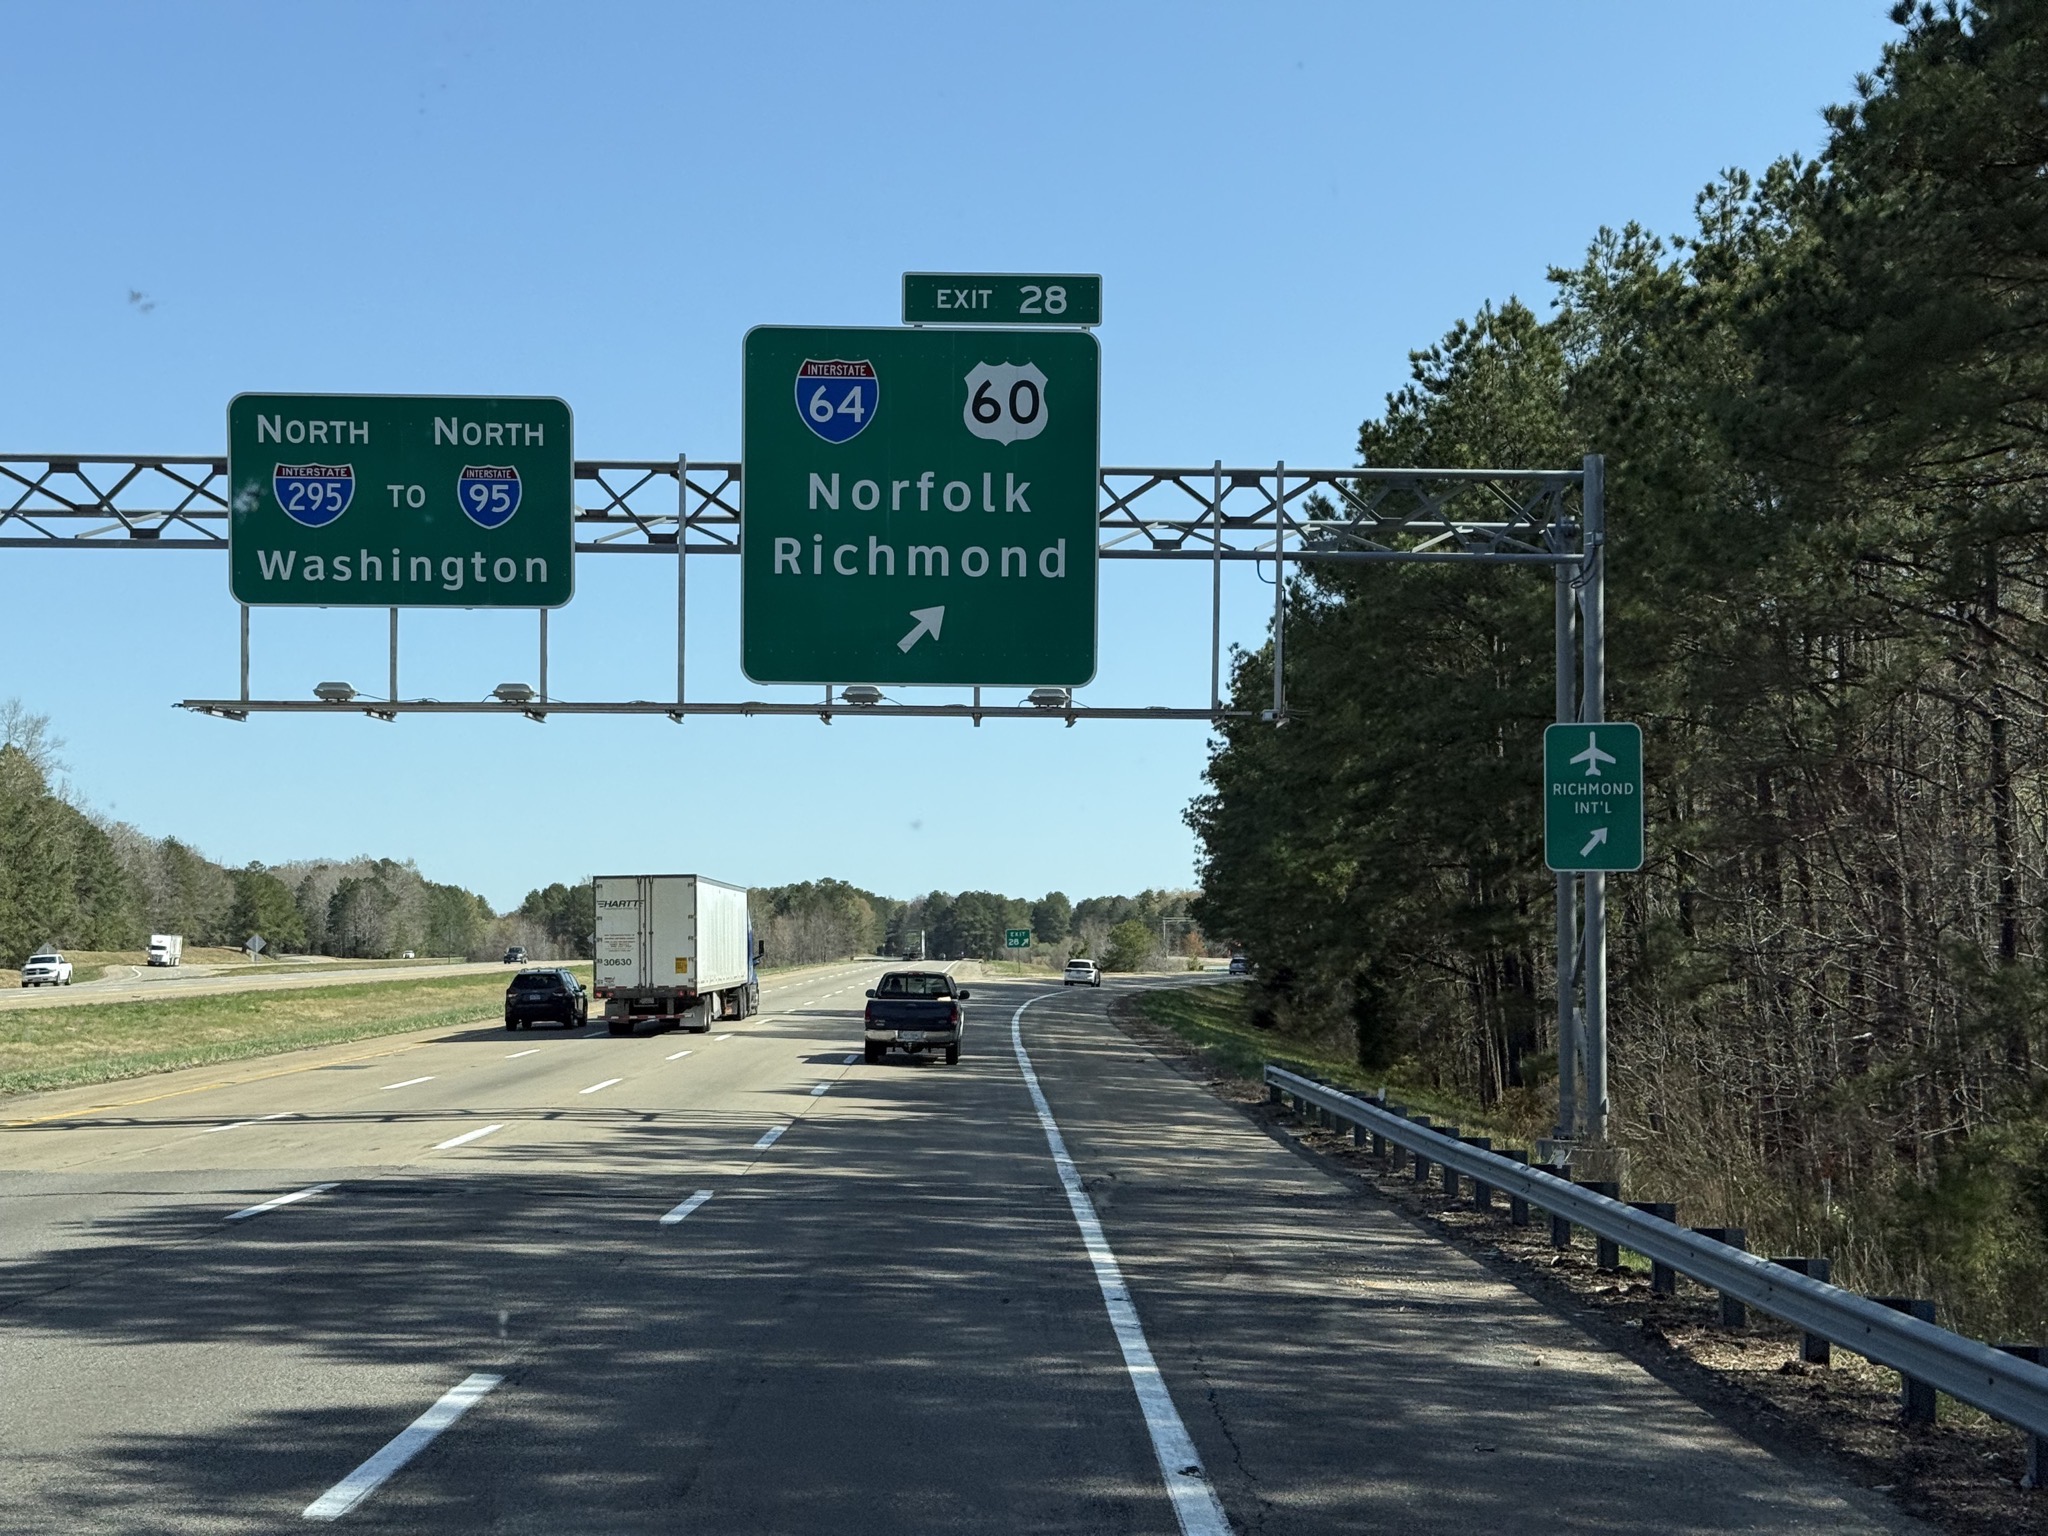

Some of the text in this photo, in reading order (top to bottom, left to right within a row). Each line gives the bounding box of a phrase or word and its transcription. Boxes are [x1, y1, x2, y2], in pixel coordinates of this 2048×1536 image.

[936, 285, 1067, 315] EXIT 28
[807, 363, 867, 376] INTERSTATE
[808, 385, 865, 423] 64
[971, 379, 1040, 425] 60
[257, 414, 369, 444] NORTH
[434, 416, 544, 446] NORTH
[281, 467, 348, 477] INTERSTATE
[466, 469, 512, 479] INTERSTATE
[288, 482, 511, 513] 295 TO 95
[808, 471, 1032, 513] Norfolk
[257, 548, 548, 591] Washington
[774, 533, 1066, 578] Richmond
[1552, 782, 1634, 795] RICHMOND
[1574, 801, 1612, 814] INT'L
[603, 958, 632, 966] 30630
